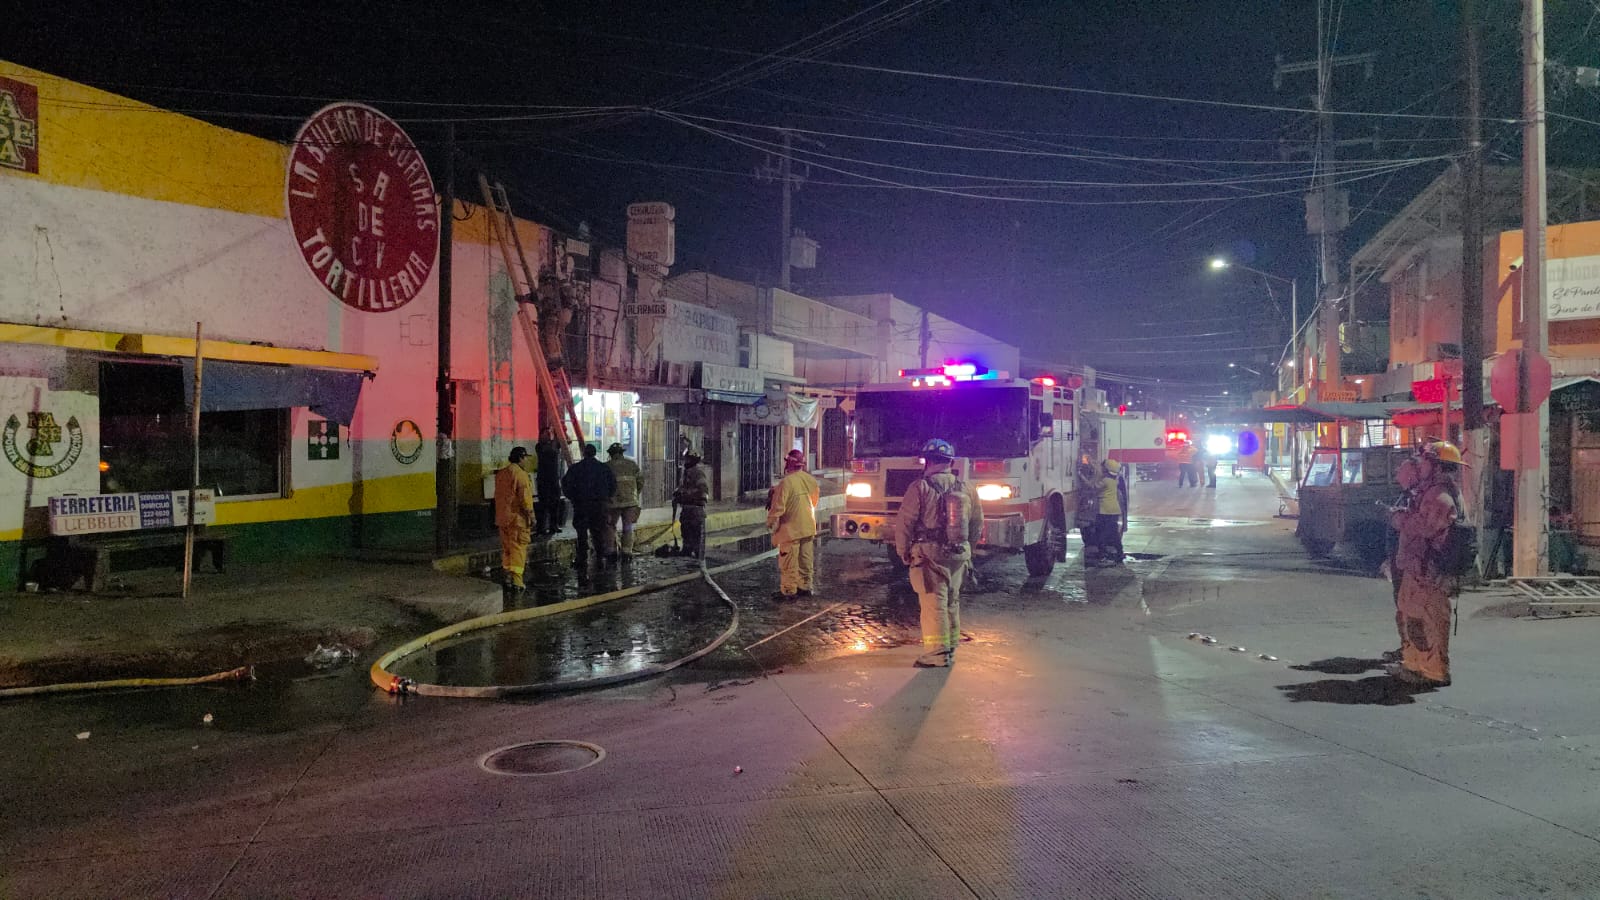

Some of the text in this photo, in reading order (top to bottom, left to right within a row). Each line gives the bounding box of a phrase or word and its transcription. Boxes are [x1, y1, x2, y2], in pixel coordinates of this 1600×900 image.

[364, 111, 387, 146] DE
[358, 202, 385, 237] DE
[302, 227, 429, 309] TORTILLERIA
[627, 304, 667, 316] ALARMAS
[51, 495, 137, 515] FERRETERIA
